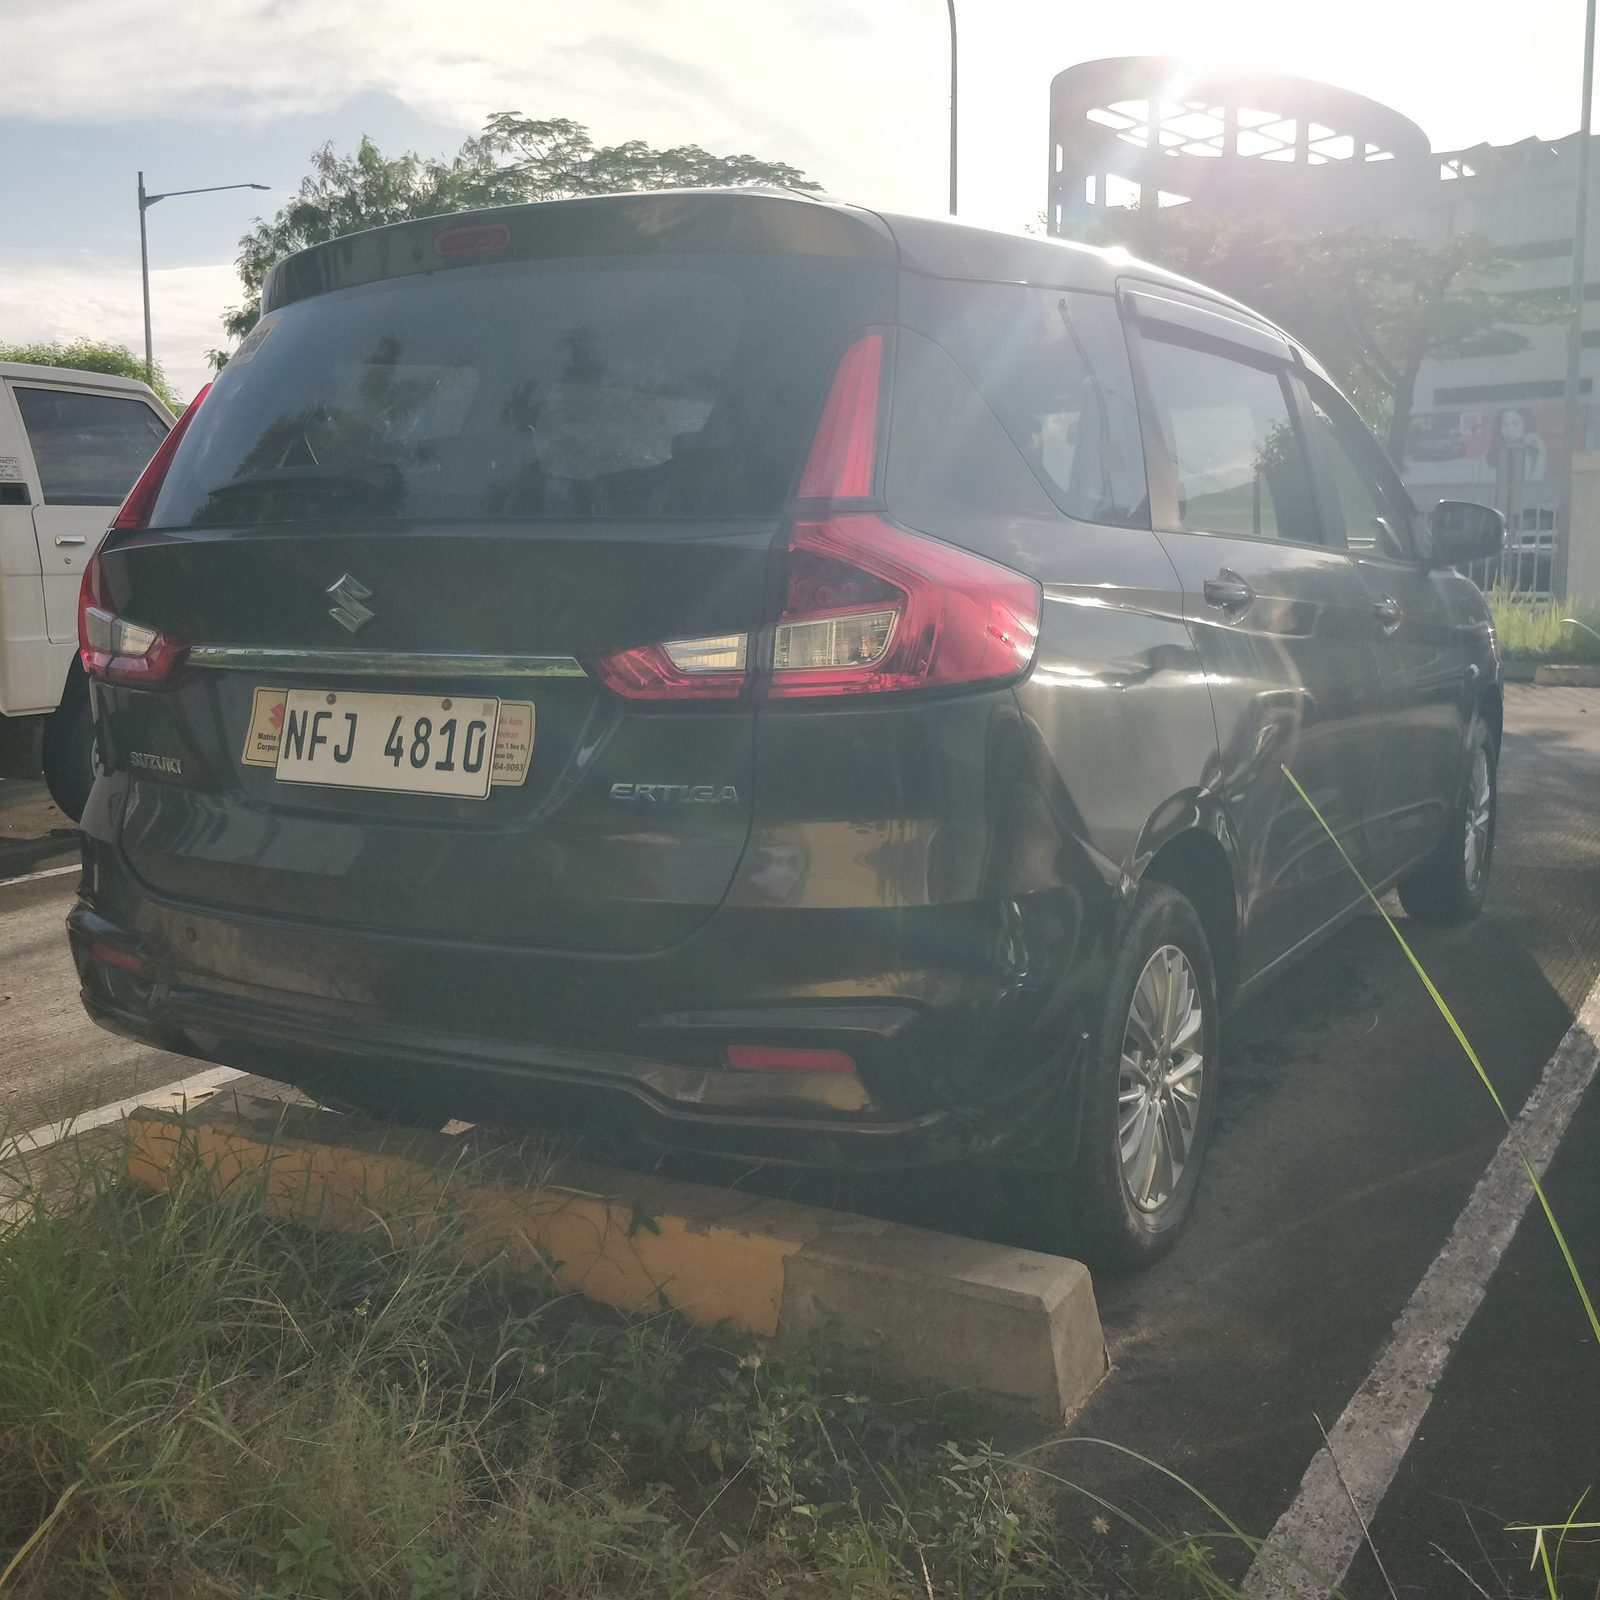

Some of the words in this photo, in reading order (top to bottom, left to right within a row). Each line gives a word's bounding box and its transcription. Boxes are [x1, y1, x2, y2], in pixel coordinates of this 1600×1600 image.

[283, 709, 358, 763] NFJ
[384, 715, 487, 774] 4810
[129, 751, 182, 774] SUZUKI
[609, 783, 739, 802] ERTIGA
